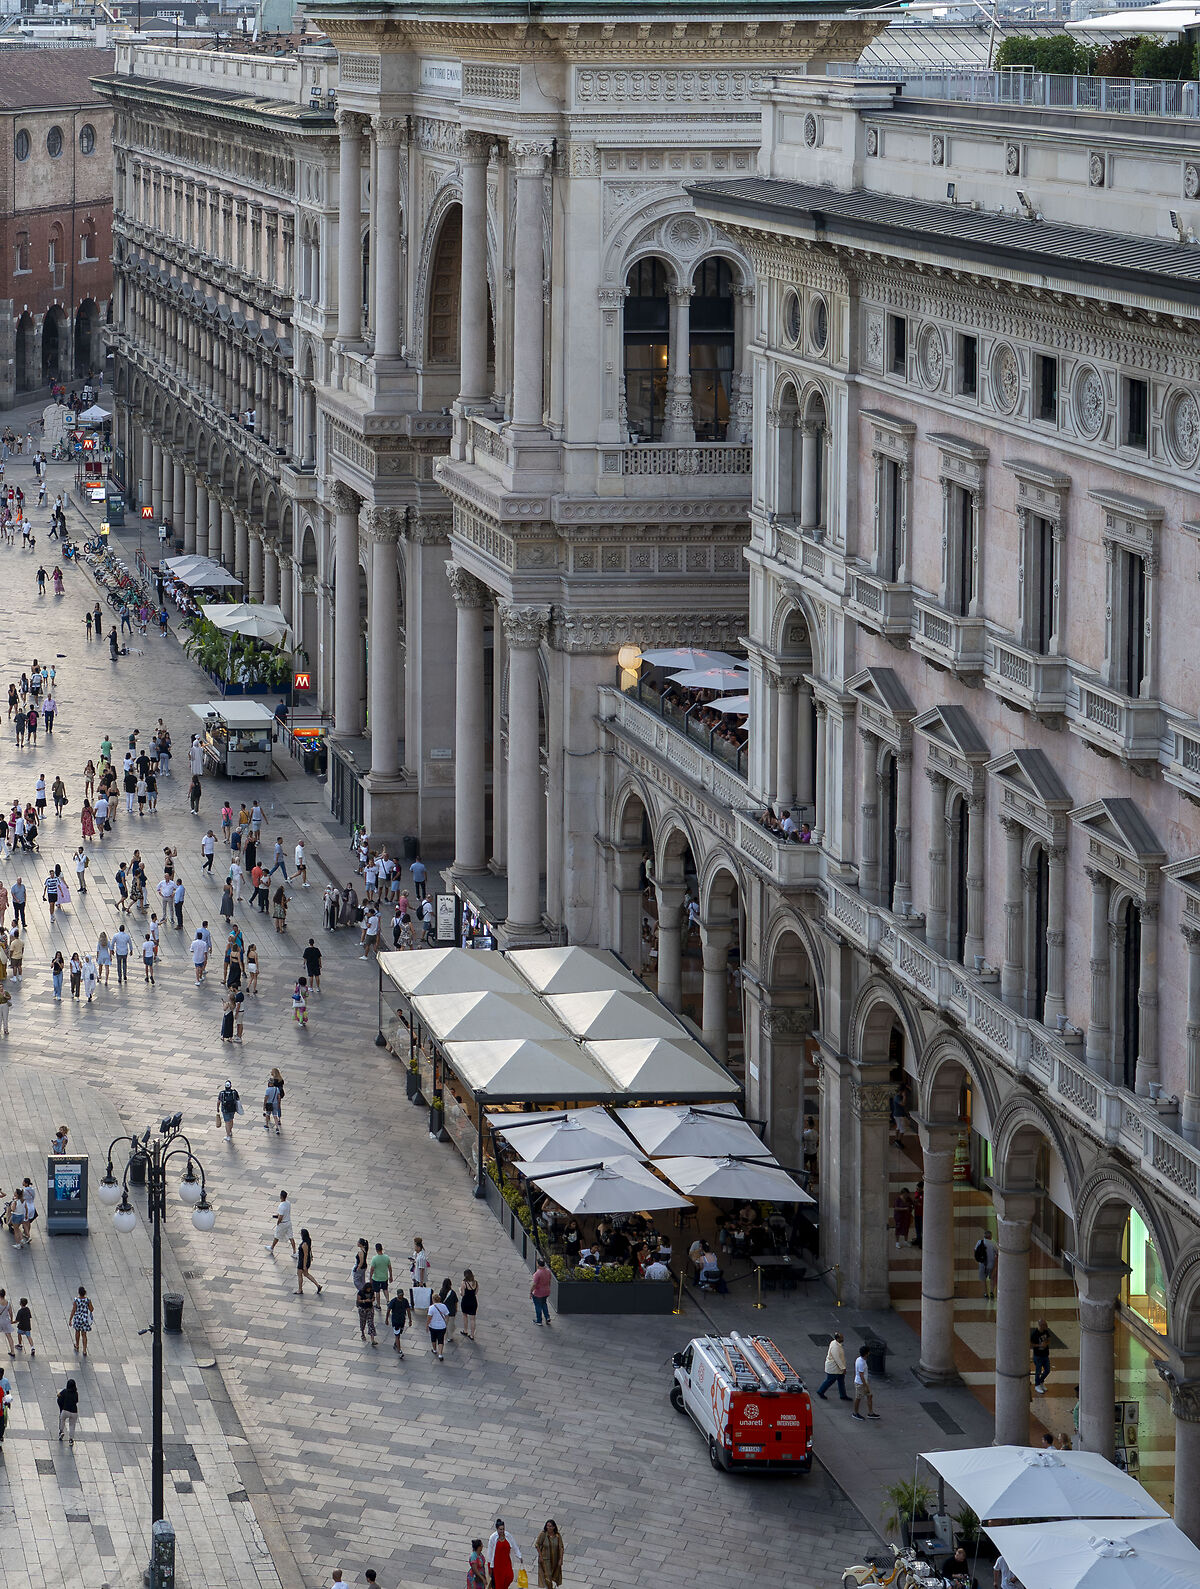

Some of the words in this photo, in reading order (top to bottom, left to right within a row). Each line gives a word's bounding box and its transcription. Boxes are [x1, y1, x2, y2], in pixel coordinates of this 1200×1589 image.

[429, 67, 446, 79] VITTORIO
[142, 509, 153, 517] M
[295, 677, 309, 687] M
[57, 1180, 79, 1188] SPORT
